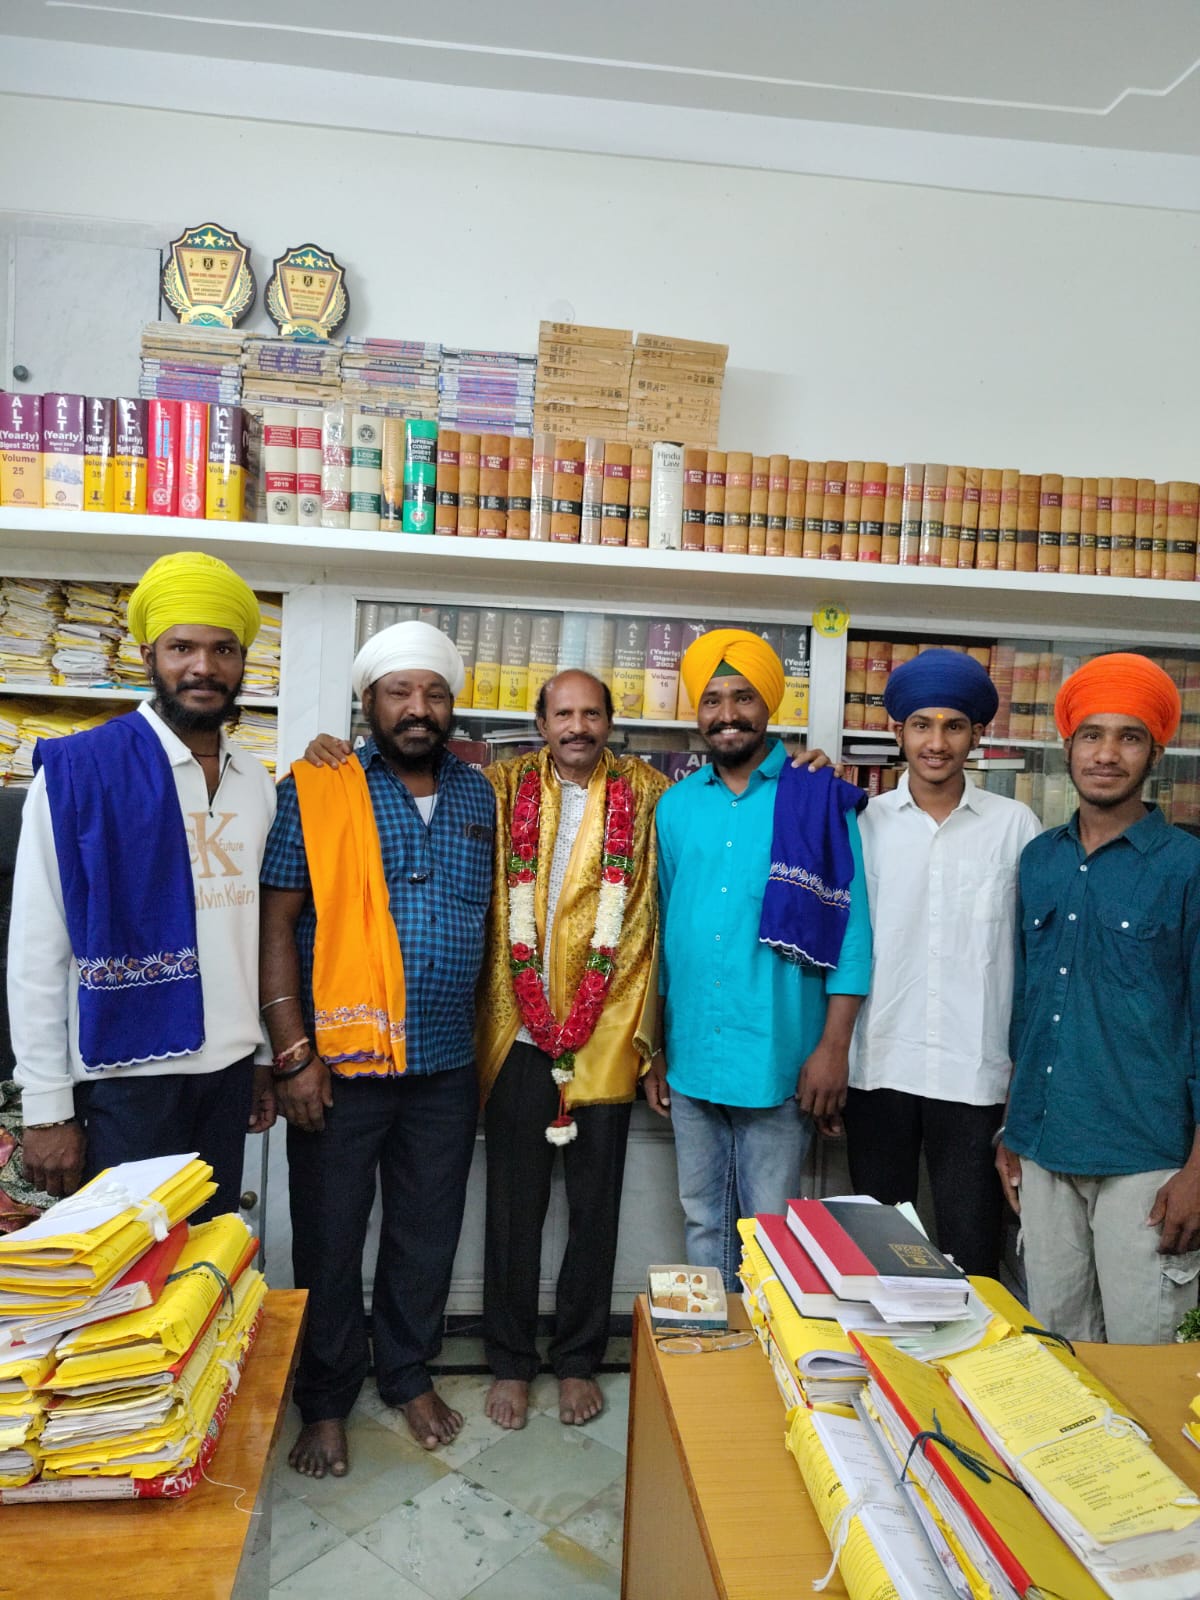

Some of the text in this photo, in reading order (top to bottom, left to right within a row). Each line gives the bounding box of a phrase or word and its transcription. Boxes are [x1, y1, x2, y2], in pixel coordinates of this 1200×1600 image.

[0, 431, 39, 442] (Yearly)
[44, 430, 82, 442] (Yearly)
[2, 454, 36, 463] Volume
[657, 451, 681, 460] Hindu
[13, 467, 24, 475] 25
[628, 623, 638, 646] ALT
[663, 624, 671, 649] ALT
[650, 649, 680, 657] (Yearly)
[614, 672, 644, 680] Volume
